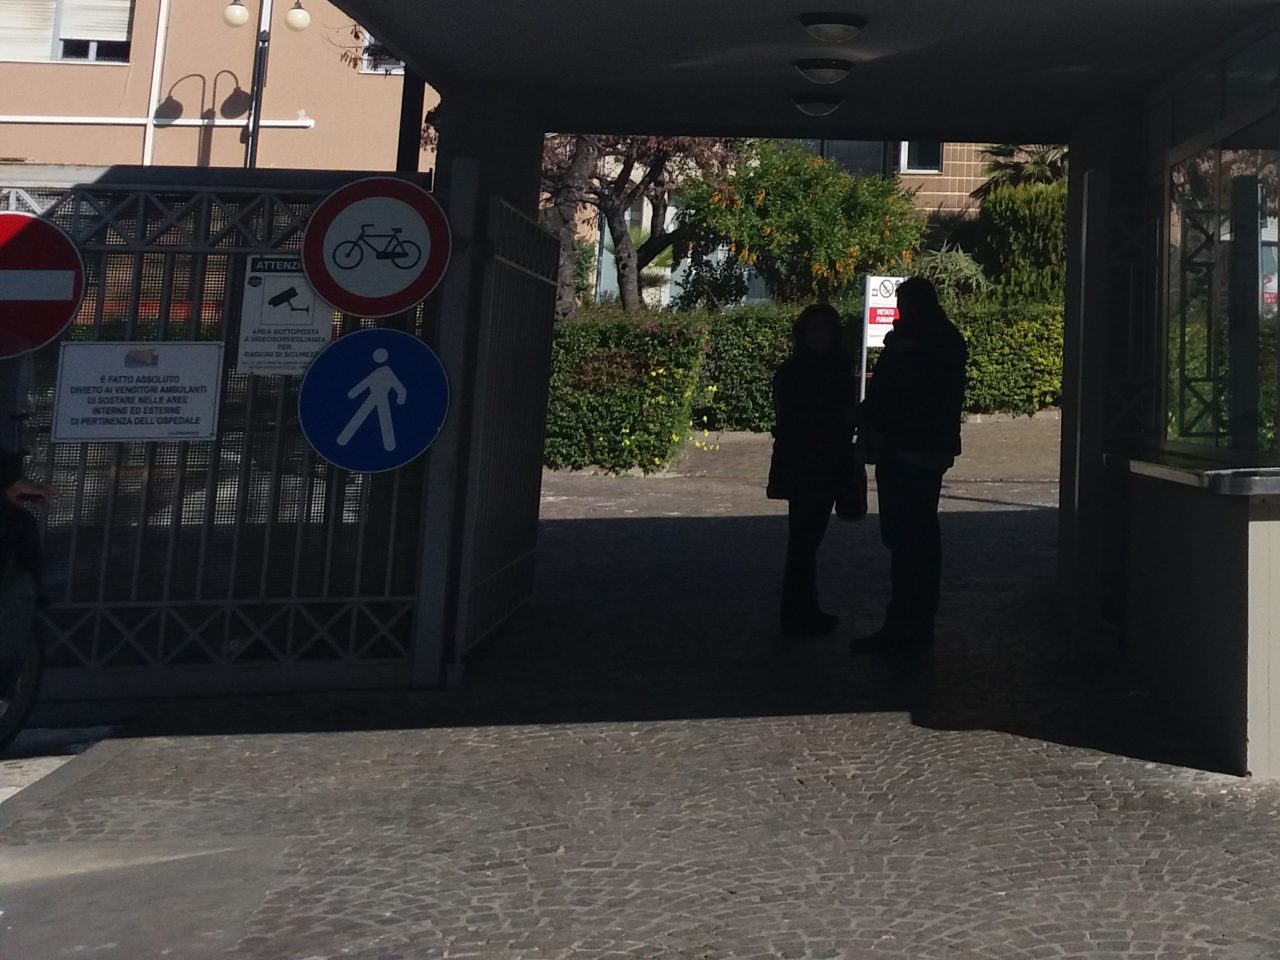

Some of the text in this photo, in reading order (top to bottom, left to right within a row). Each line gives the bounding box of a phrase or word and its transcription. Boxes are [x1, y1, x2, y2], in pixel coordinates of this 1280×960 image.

[70, 386, 102, 394] DIVIETO
[81, 417, 132, 425] PERTINENZA
[134, 417, 200, 425] DELL'OSPEDALE
